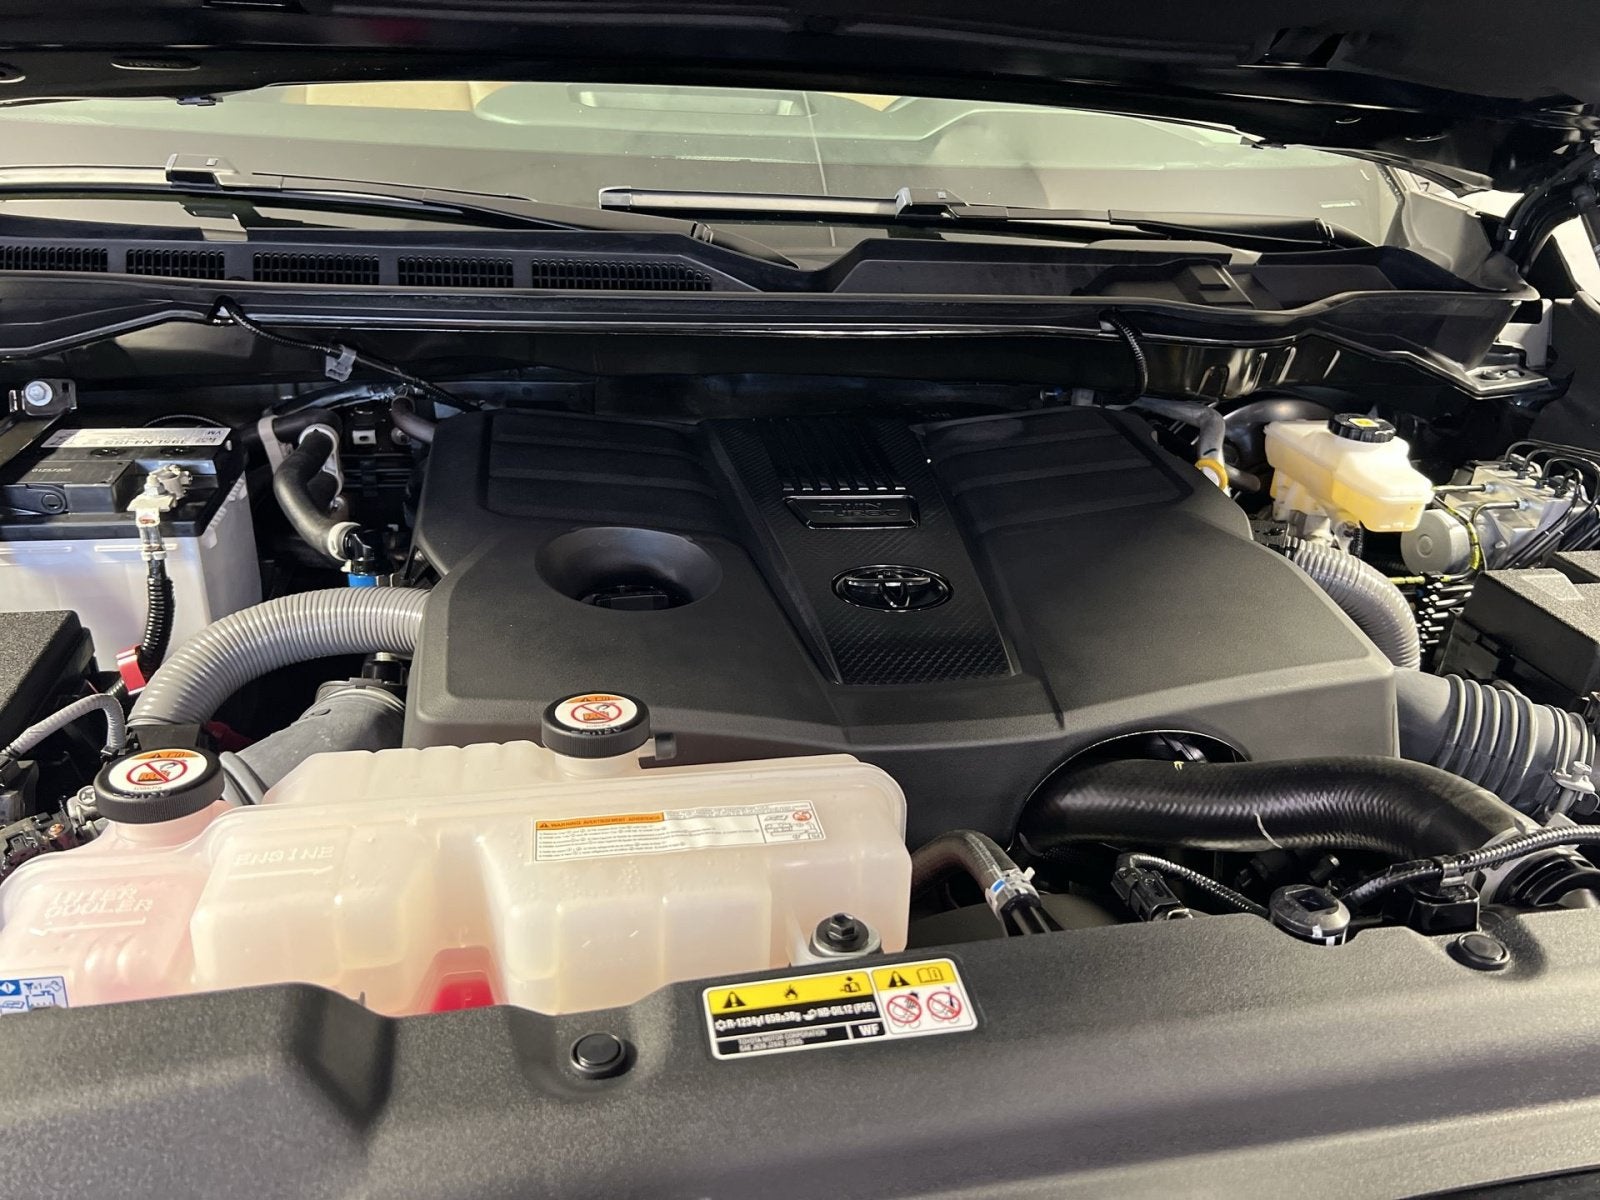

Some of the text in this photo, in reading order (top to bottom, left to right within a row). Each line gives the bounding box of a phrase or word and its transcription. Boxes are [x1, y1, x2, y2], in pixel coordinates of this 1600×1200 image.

[234, 846, 335, 866] ENGINE
[45, 899, 153, 917] COOLER
[858, 1023, 880, 1037] WF
